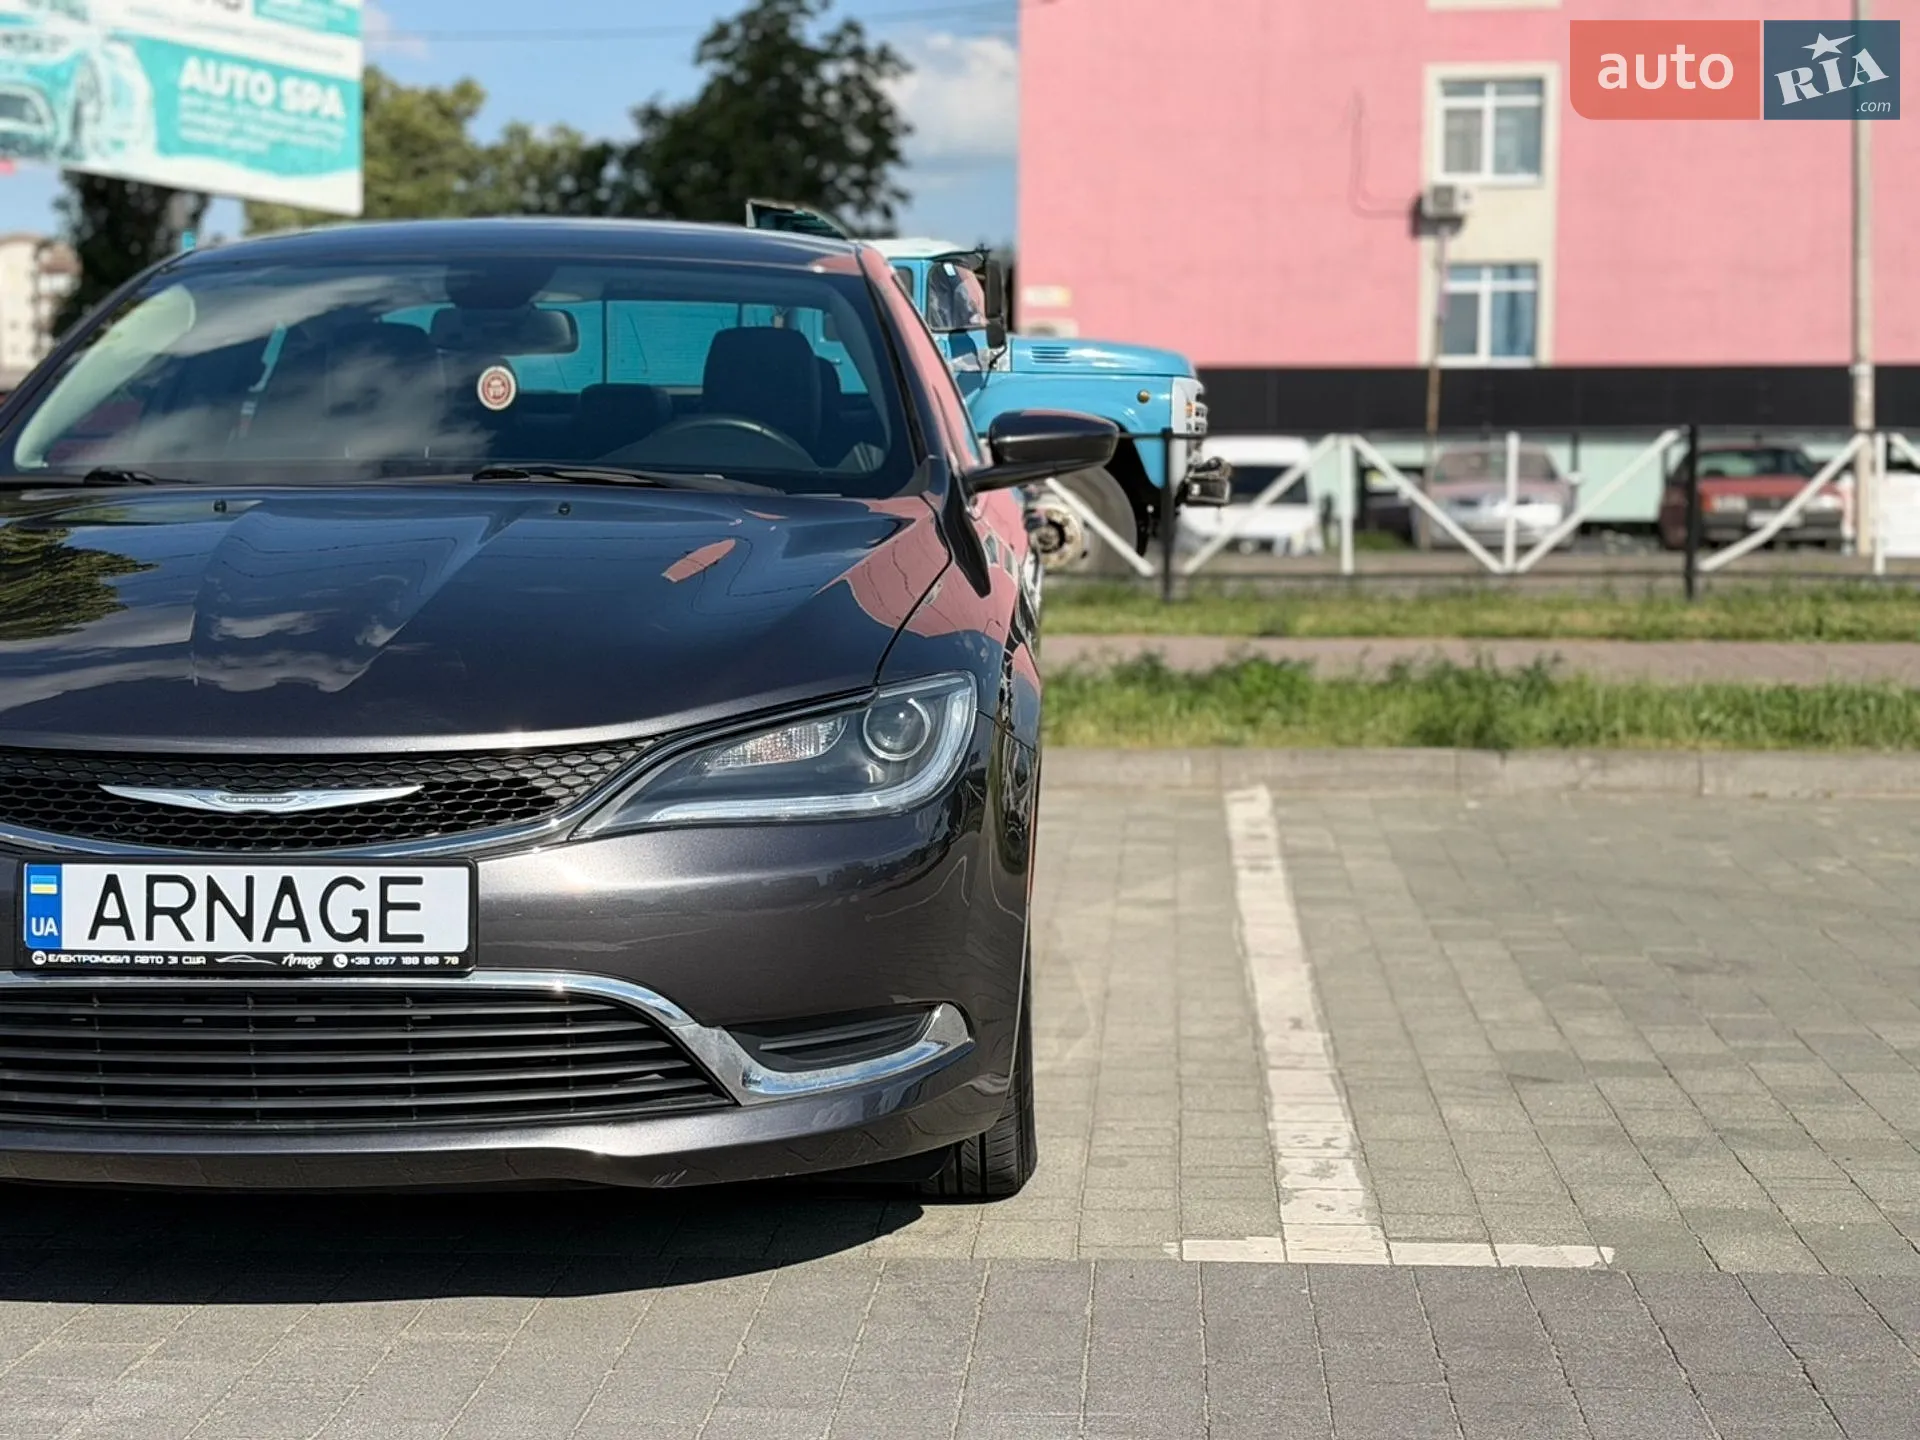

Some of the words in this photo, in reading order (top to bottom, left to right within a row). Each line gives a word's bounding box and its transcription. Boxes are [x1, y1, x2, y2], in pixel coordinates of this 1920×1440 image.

[178, 55, 277, 107] AUTO
[280, 75, 347, 119] SPA
[87, 873, 425, 944] ARNAGE
[31, 916, 59, 936] UA
[181, 955, 208, 966] США
[281, 953, 324, 970] Arnage
